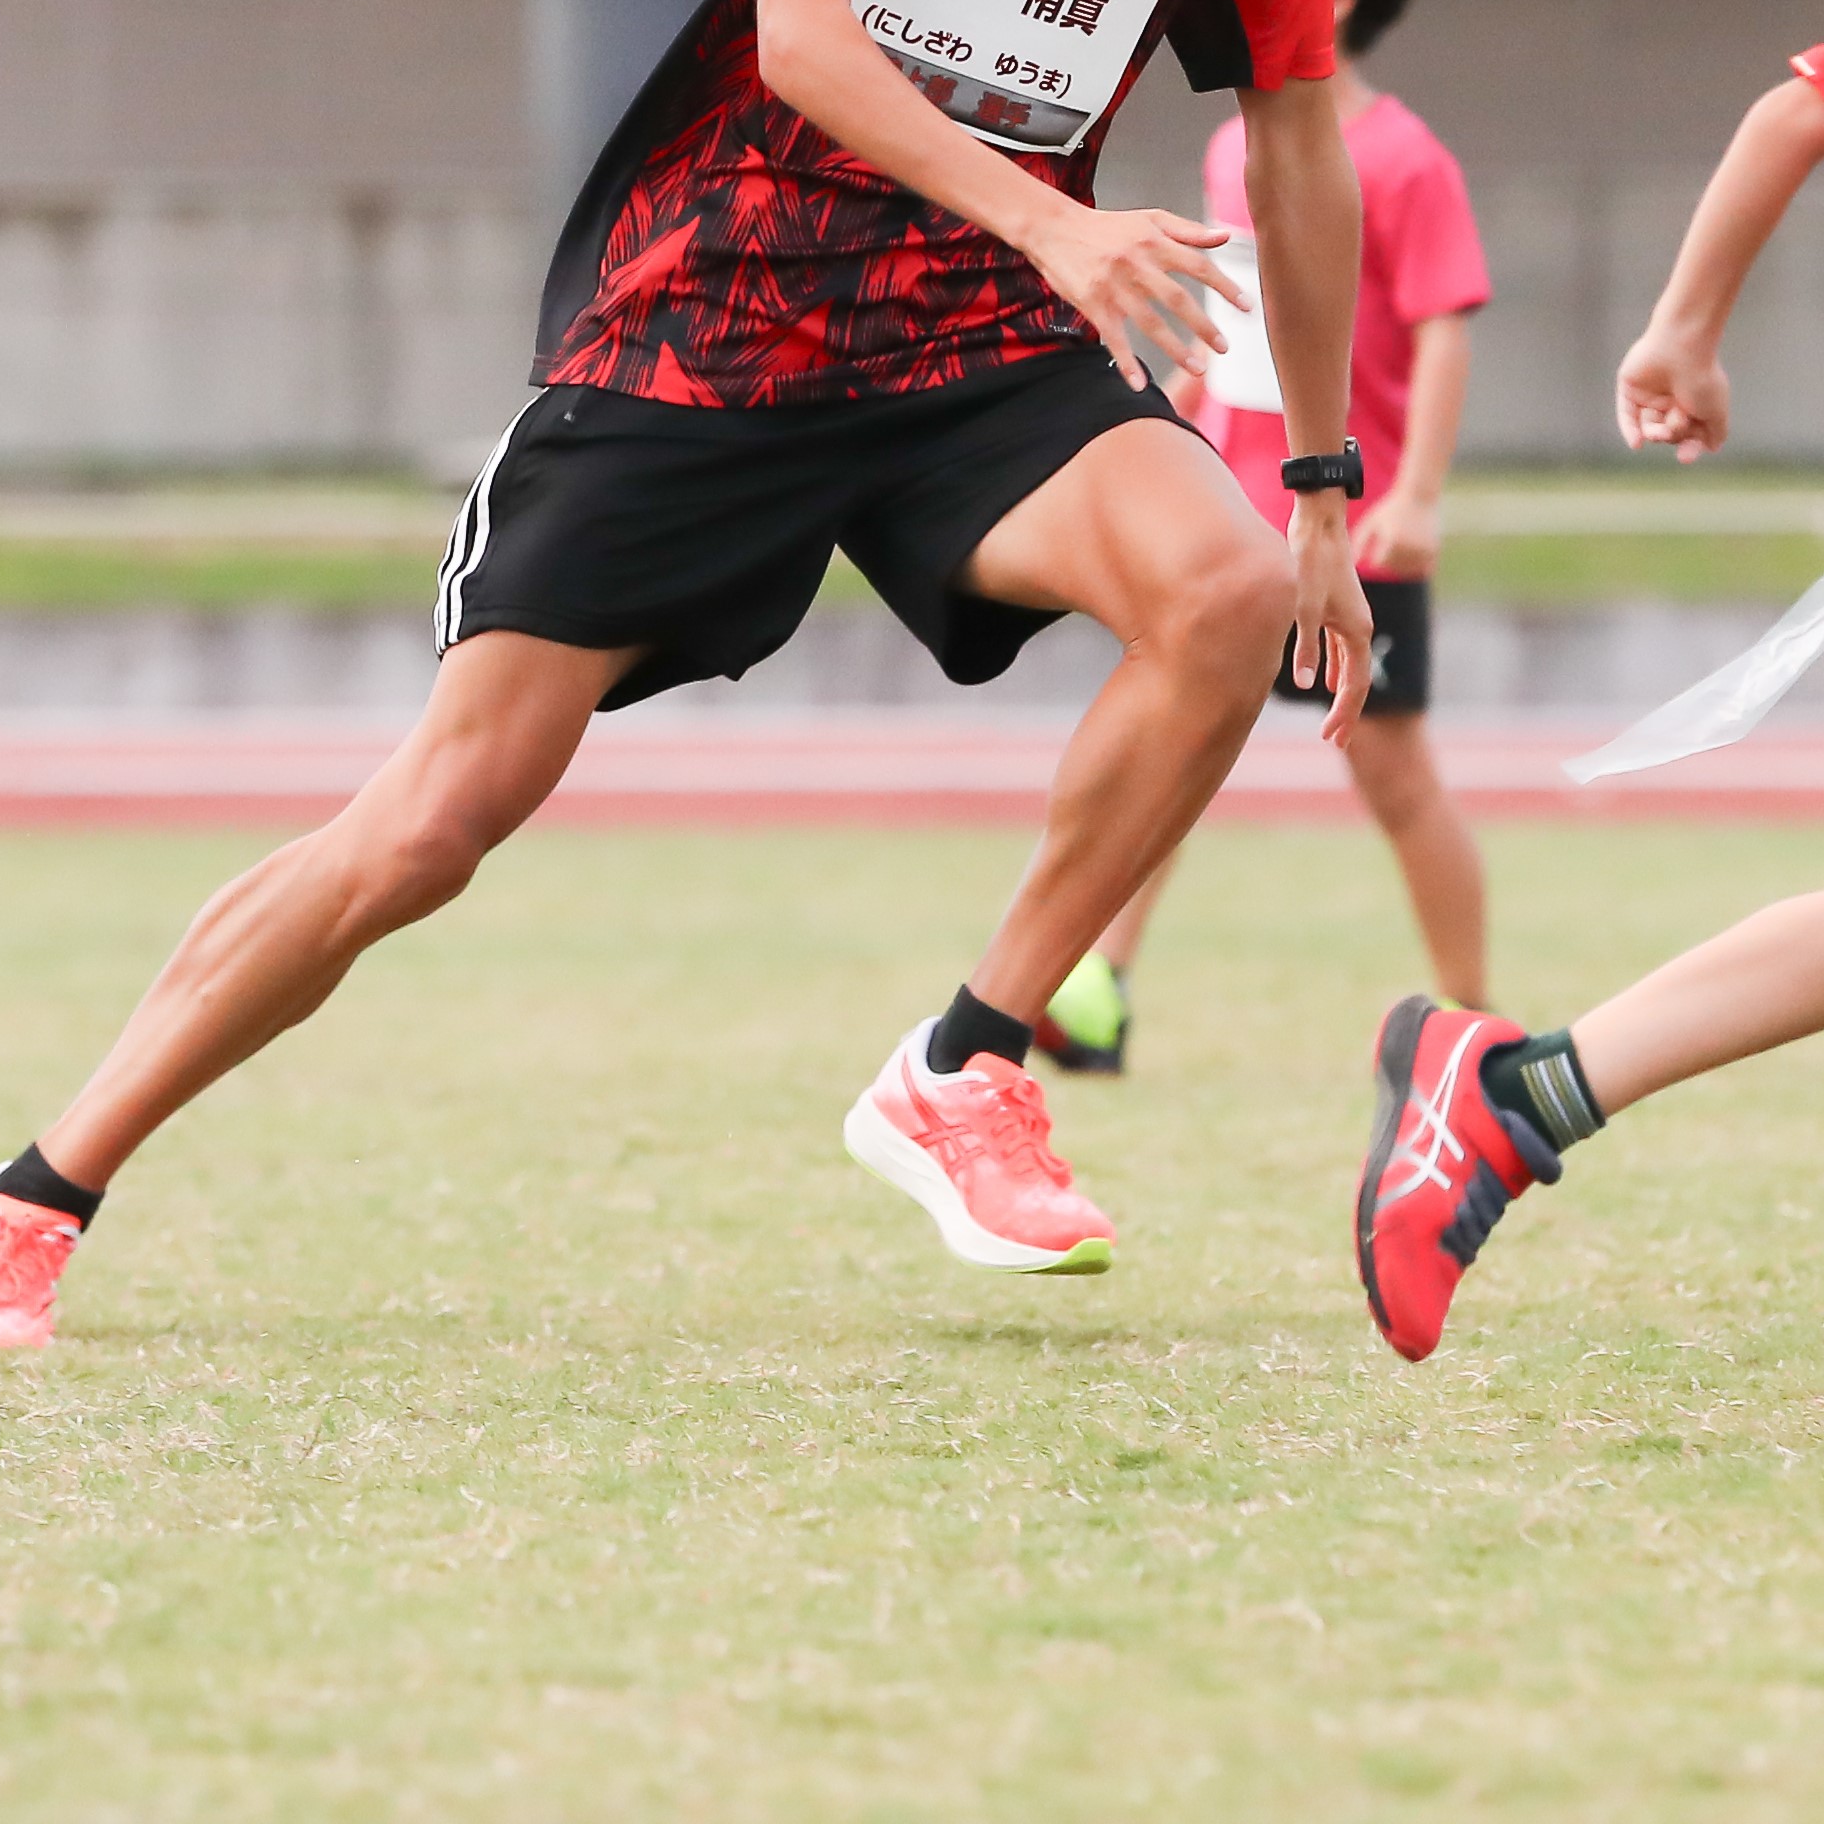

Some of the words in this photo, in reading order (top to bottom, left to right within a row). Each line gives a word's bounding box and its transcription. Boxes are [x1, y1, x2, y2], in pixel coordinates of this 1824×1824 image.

[861, 4, 973, 64] (にしざわ
[994, 52, 1076, 100] ゆうま)
